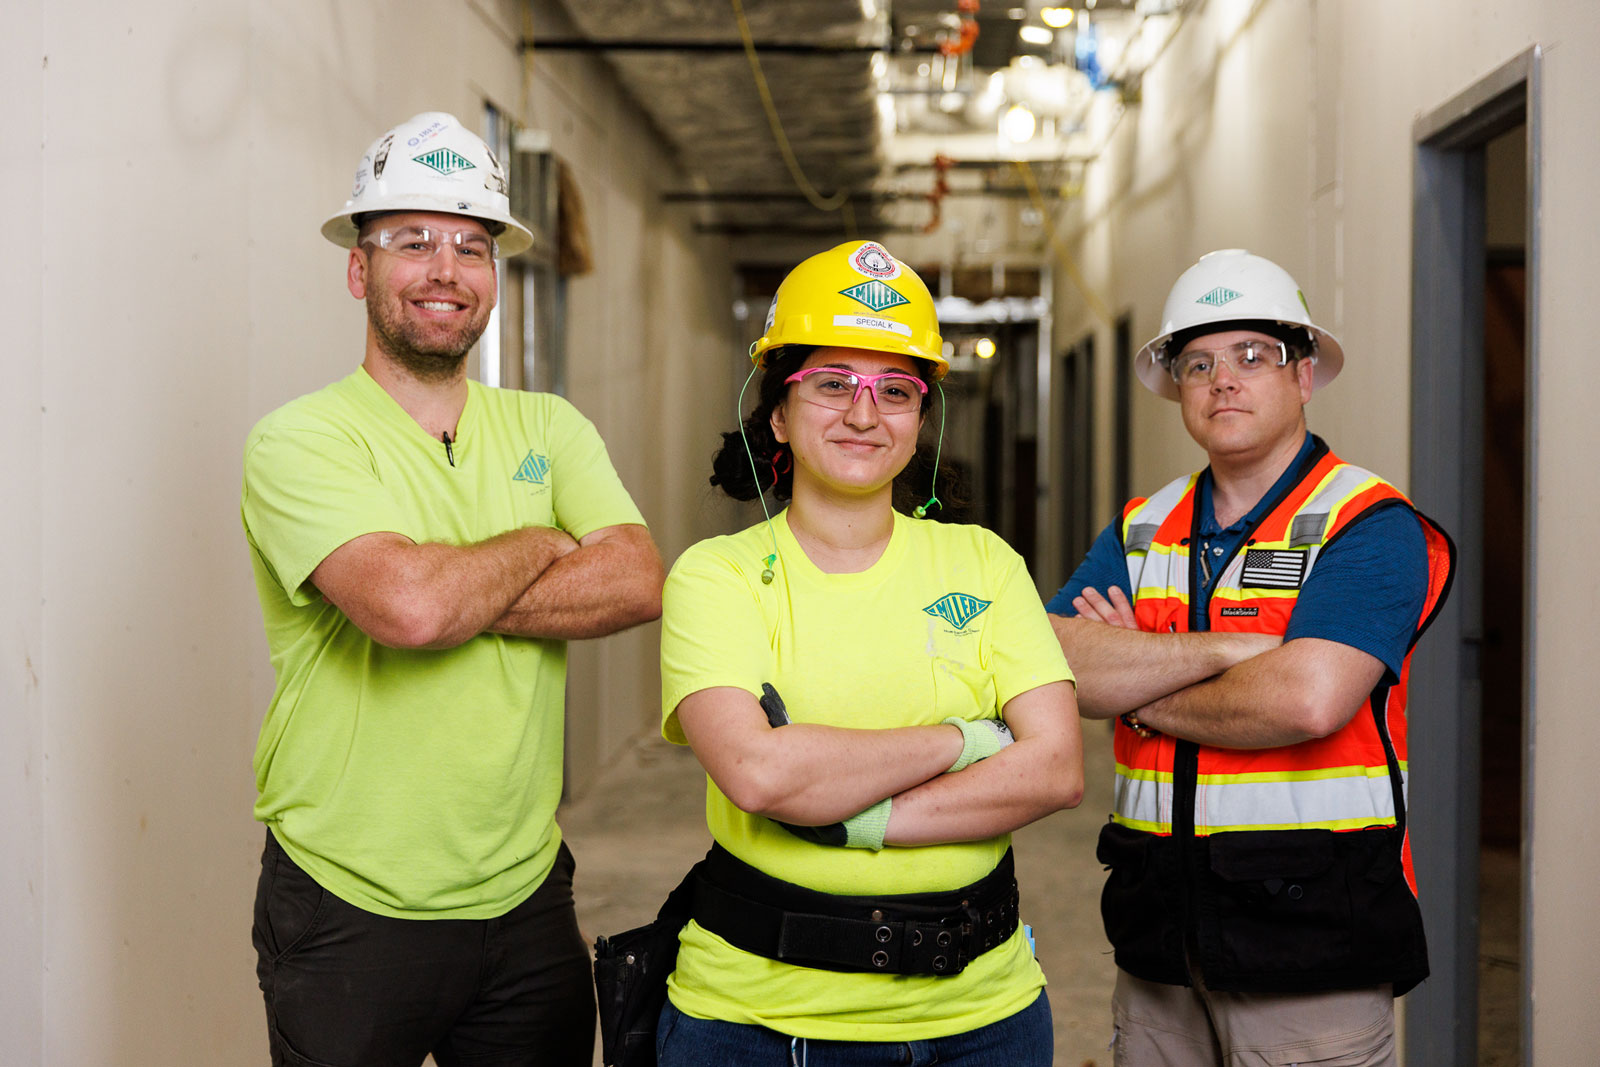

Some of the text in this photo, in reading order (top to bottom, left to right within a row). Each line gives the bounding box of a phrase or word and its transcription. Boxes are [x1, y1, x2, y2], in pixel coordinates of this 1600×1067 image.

[855, 282, 898, 308] MILLER
[1205, 288, 1234, 305] MILLER
[856, 318, 887, 329] SPECIAL
[935, 595, 978, 627] MILLER
